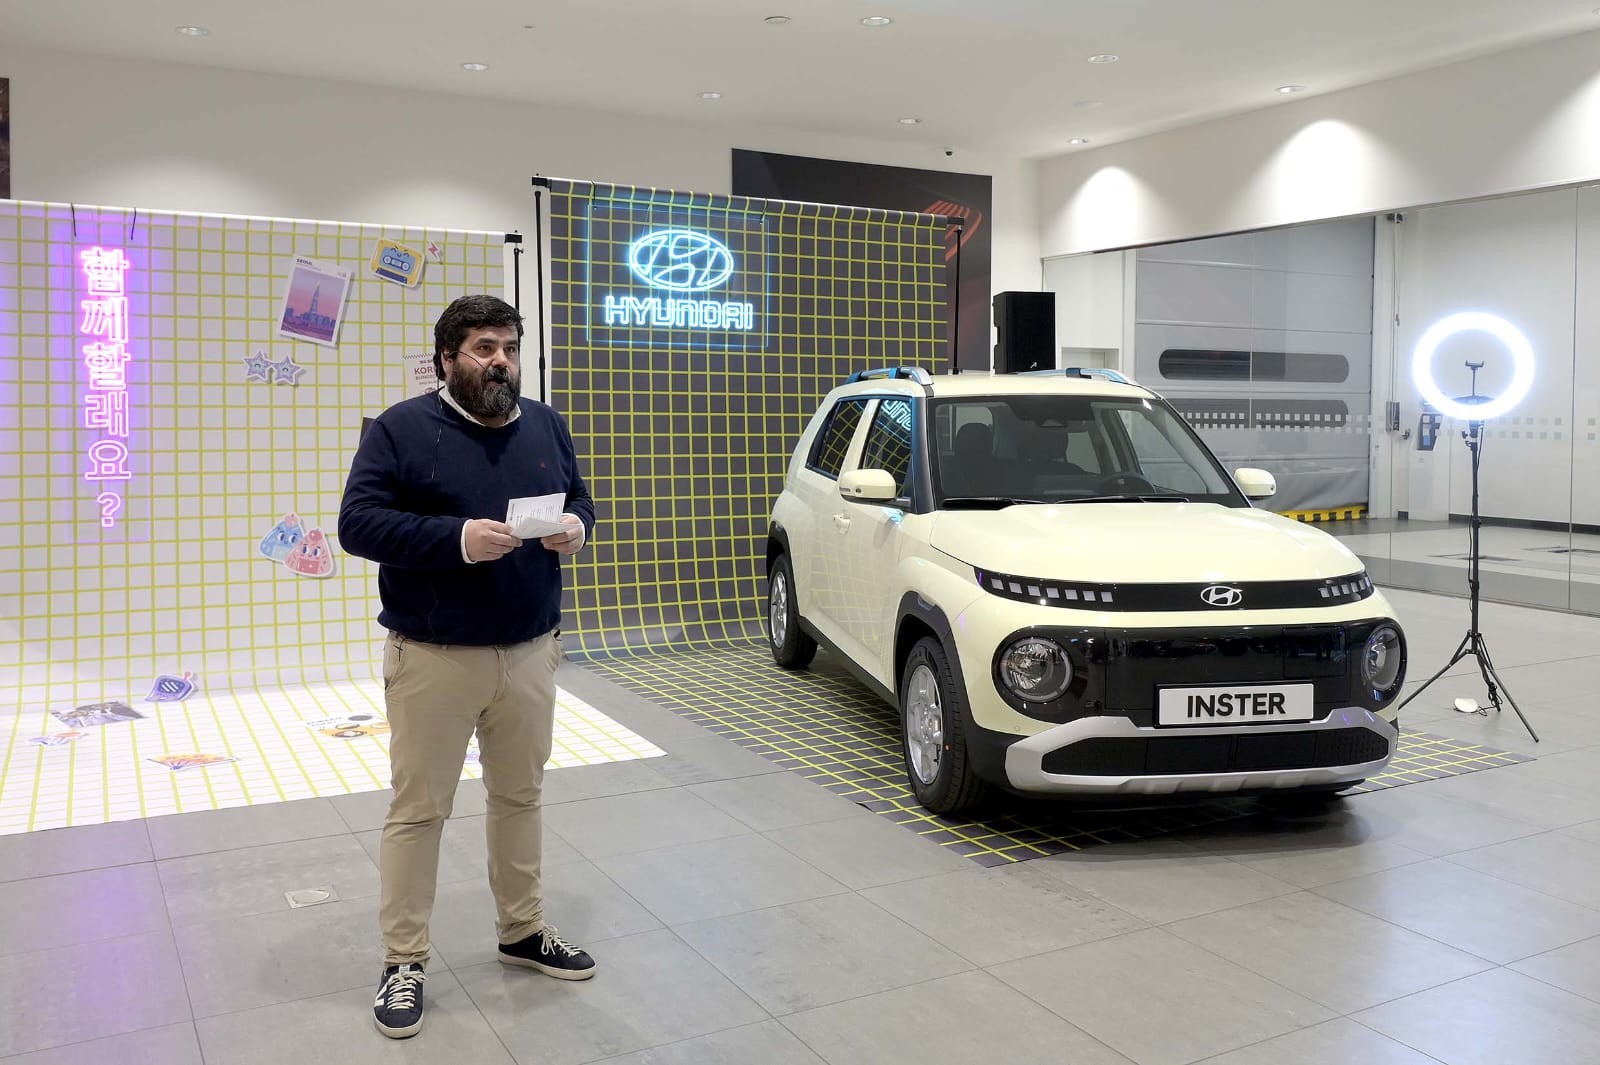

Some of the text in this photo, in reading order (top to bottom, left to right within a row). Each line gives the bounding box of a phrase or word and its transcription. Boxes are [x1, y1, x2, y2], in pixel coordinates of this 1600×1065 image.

[605, 296, 754, 330] HYUNDAI
[414, 366, 437, 375] KOR
[1187, 692, 1286, 718] INSTER
